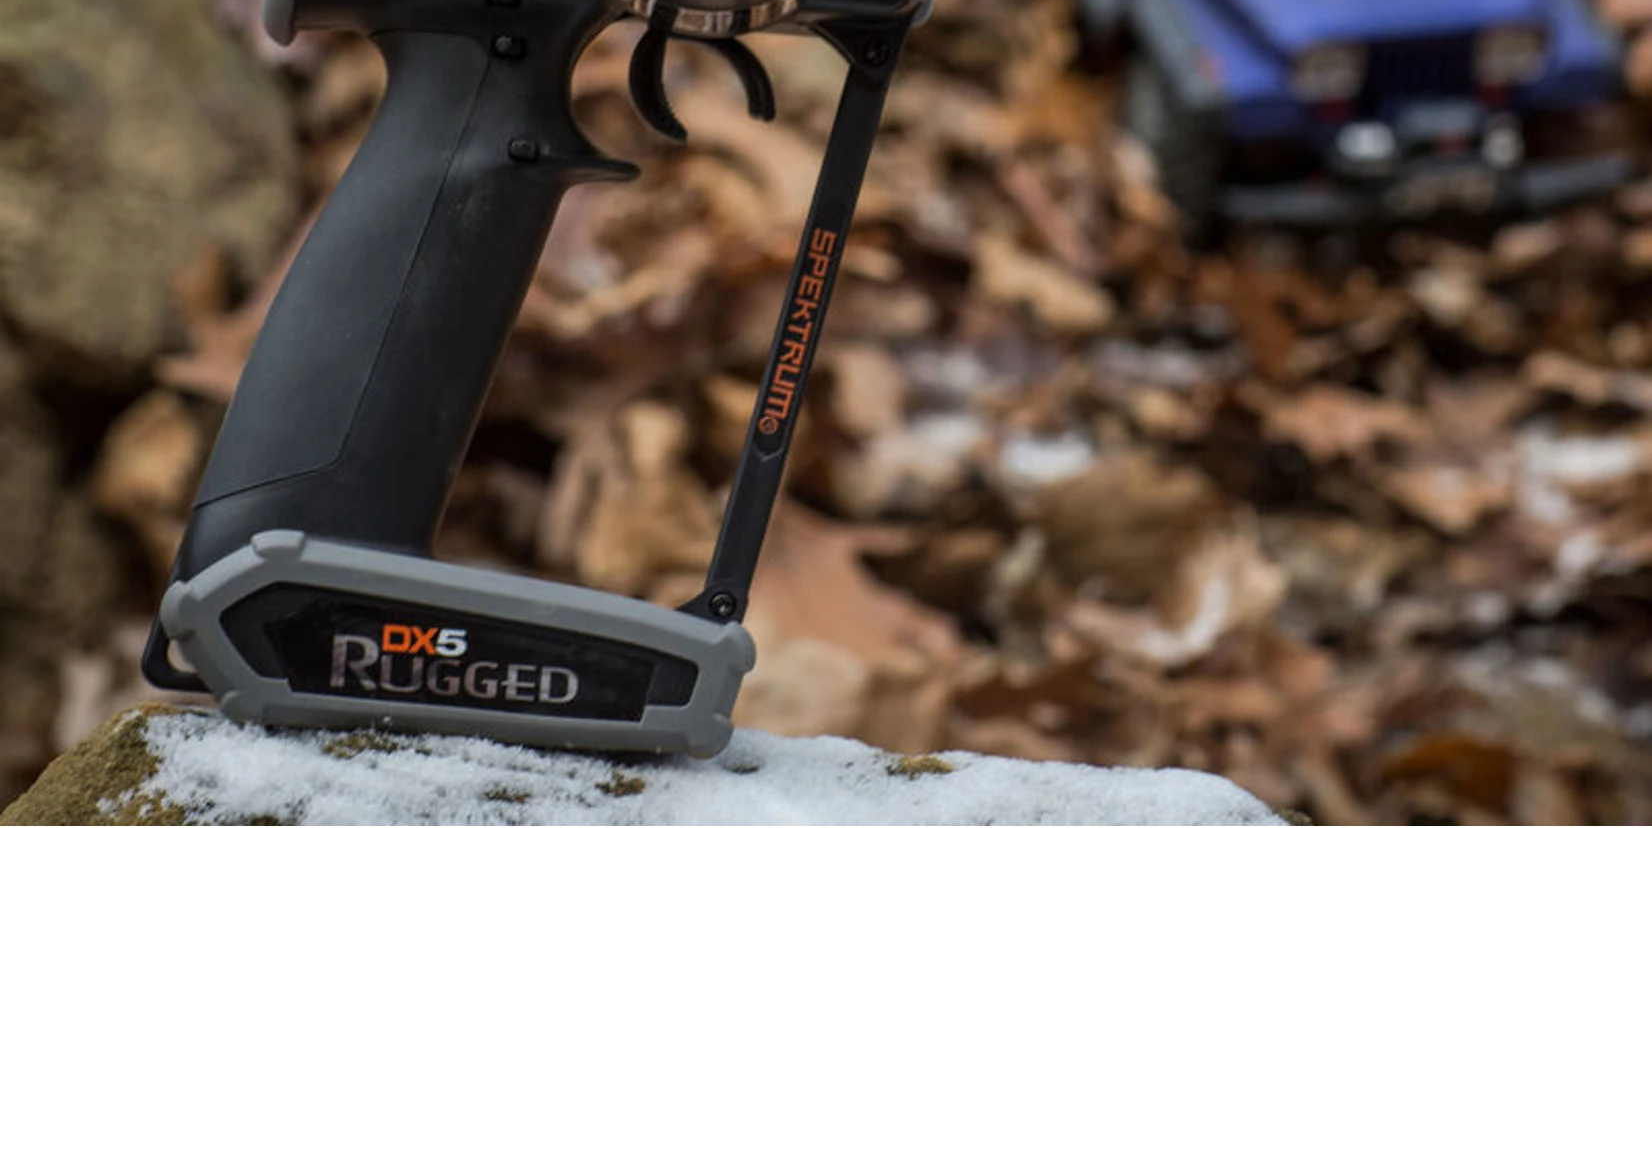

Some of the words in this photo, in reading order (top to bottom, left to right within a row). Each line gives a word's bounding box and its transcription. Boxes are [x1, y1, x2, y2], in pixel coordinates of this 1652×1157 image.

[763, 227, 837, 420] SPEKTRUM
[329, 634, 580, 705] RUGGED
[382, 623, 468, 658] DX5
